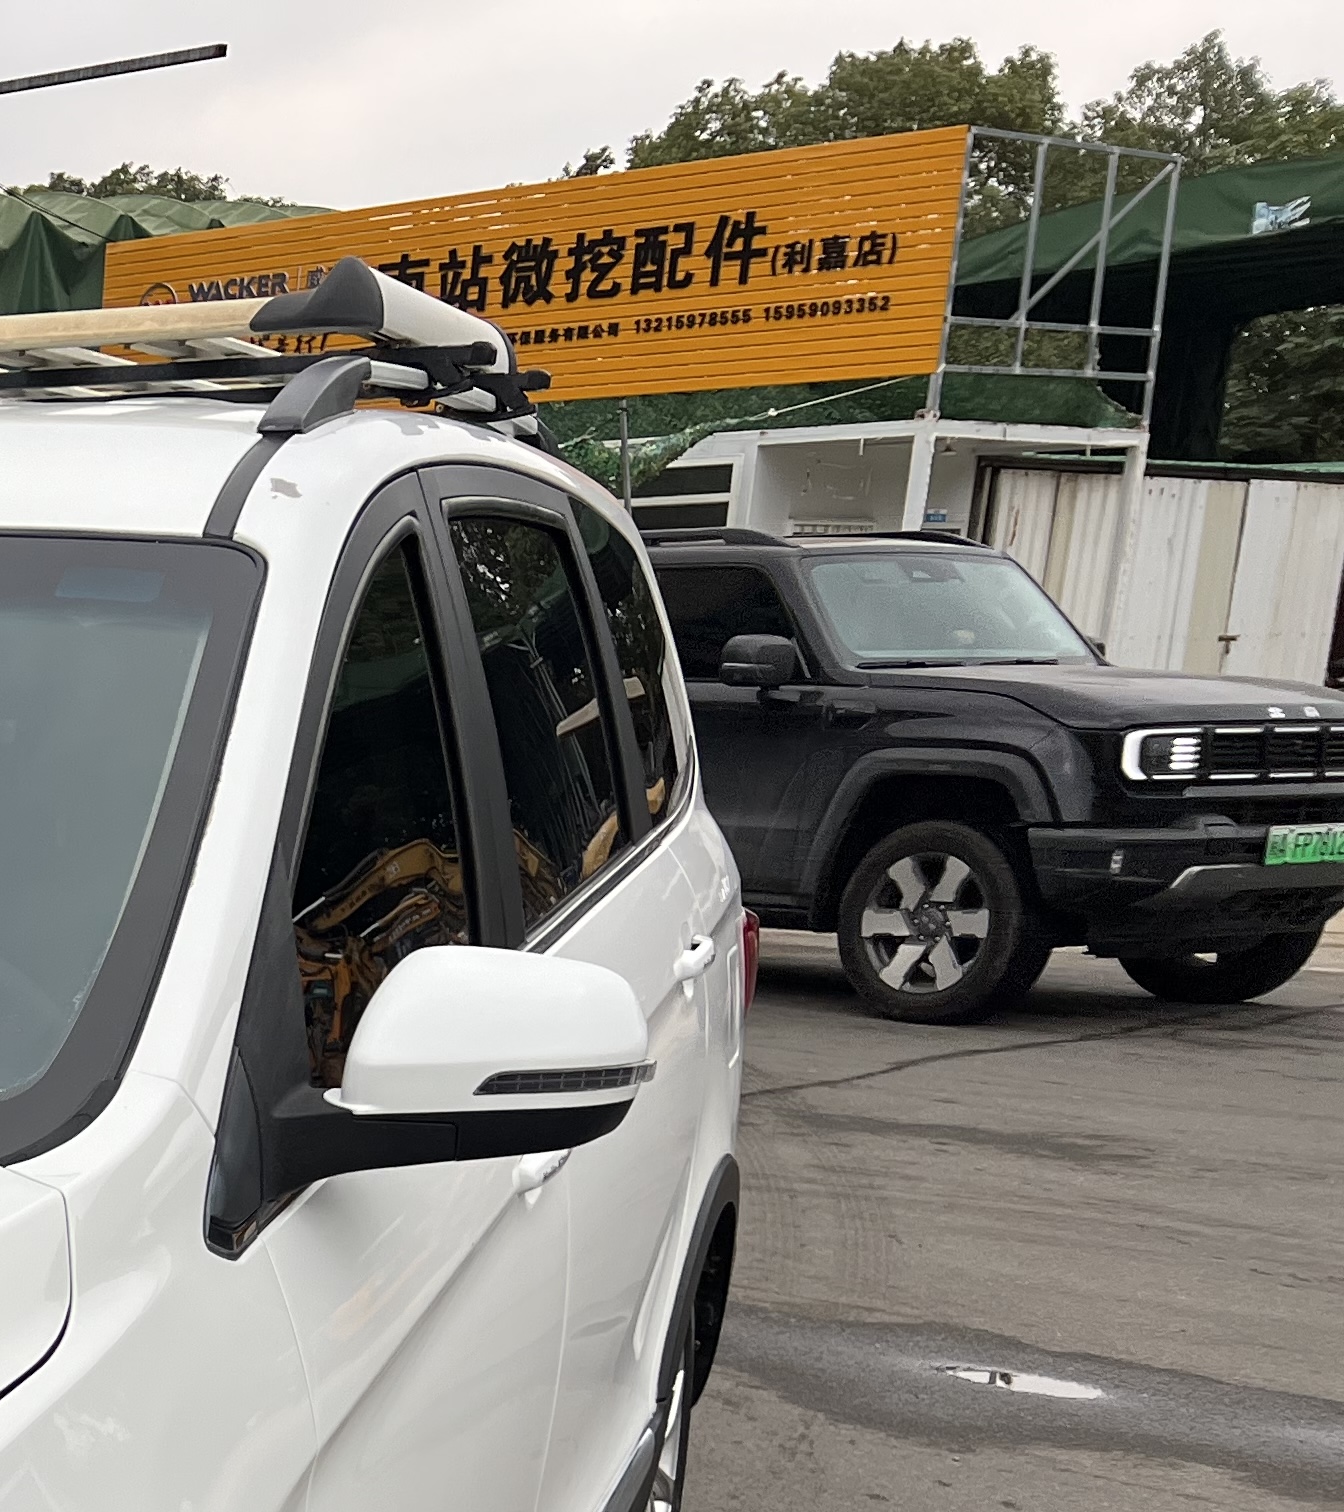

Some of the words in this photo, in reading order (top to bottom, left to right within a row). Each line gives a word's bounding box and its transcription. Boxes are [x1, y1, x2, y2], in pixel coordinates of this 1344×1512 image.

[188, 271, 290, 302] WACKER
[633, 307, 753, 334] 13215978555
[763, 294, 892, 322] 15959093352
